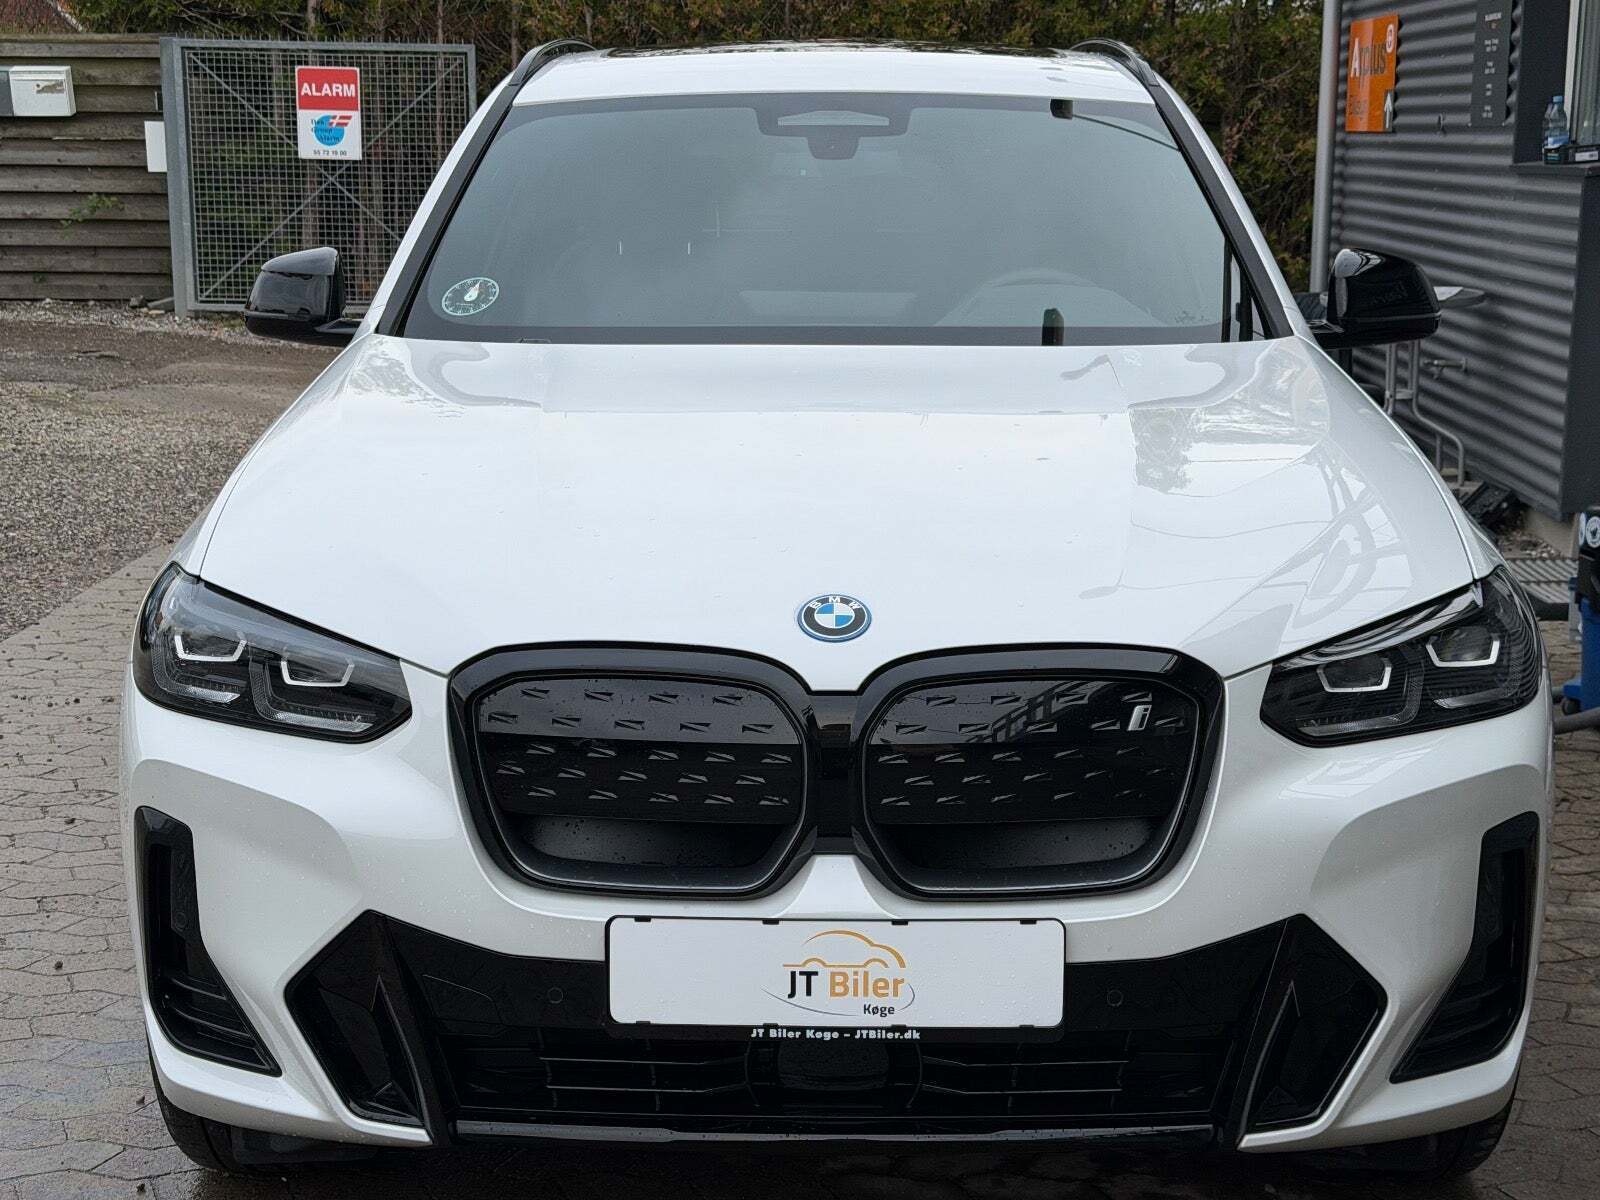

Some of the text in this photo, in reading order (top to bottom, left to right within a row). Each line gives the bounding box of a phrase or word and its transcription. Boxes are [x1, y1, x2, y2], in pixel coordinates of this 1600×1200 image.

[301, 82, 355, 97] ALARM
[808, 595, 862, 609] BMW
[787, 970, 905, 999] JT Biler
[863, 1003, 895, 1018] Køge
[750, 1028, 765, 1039] JT
[769, 1028, 802, 1039] Biler
[854, 1028, 921, 1040] JTBiler.dk
